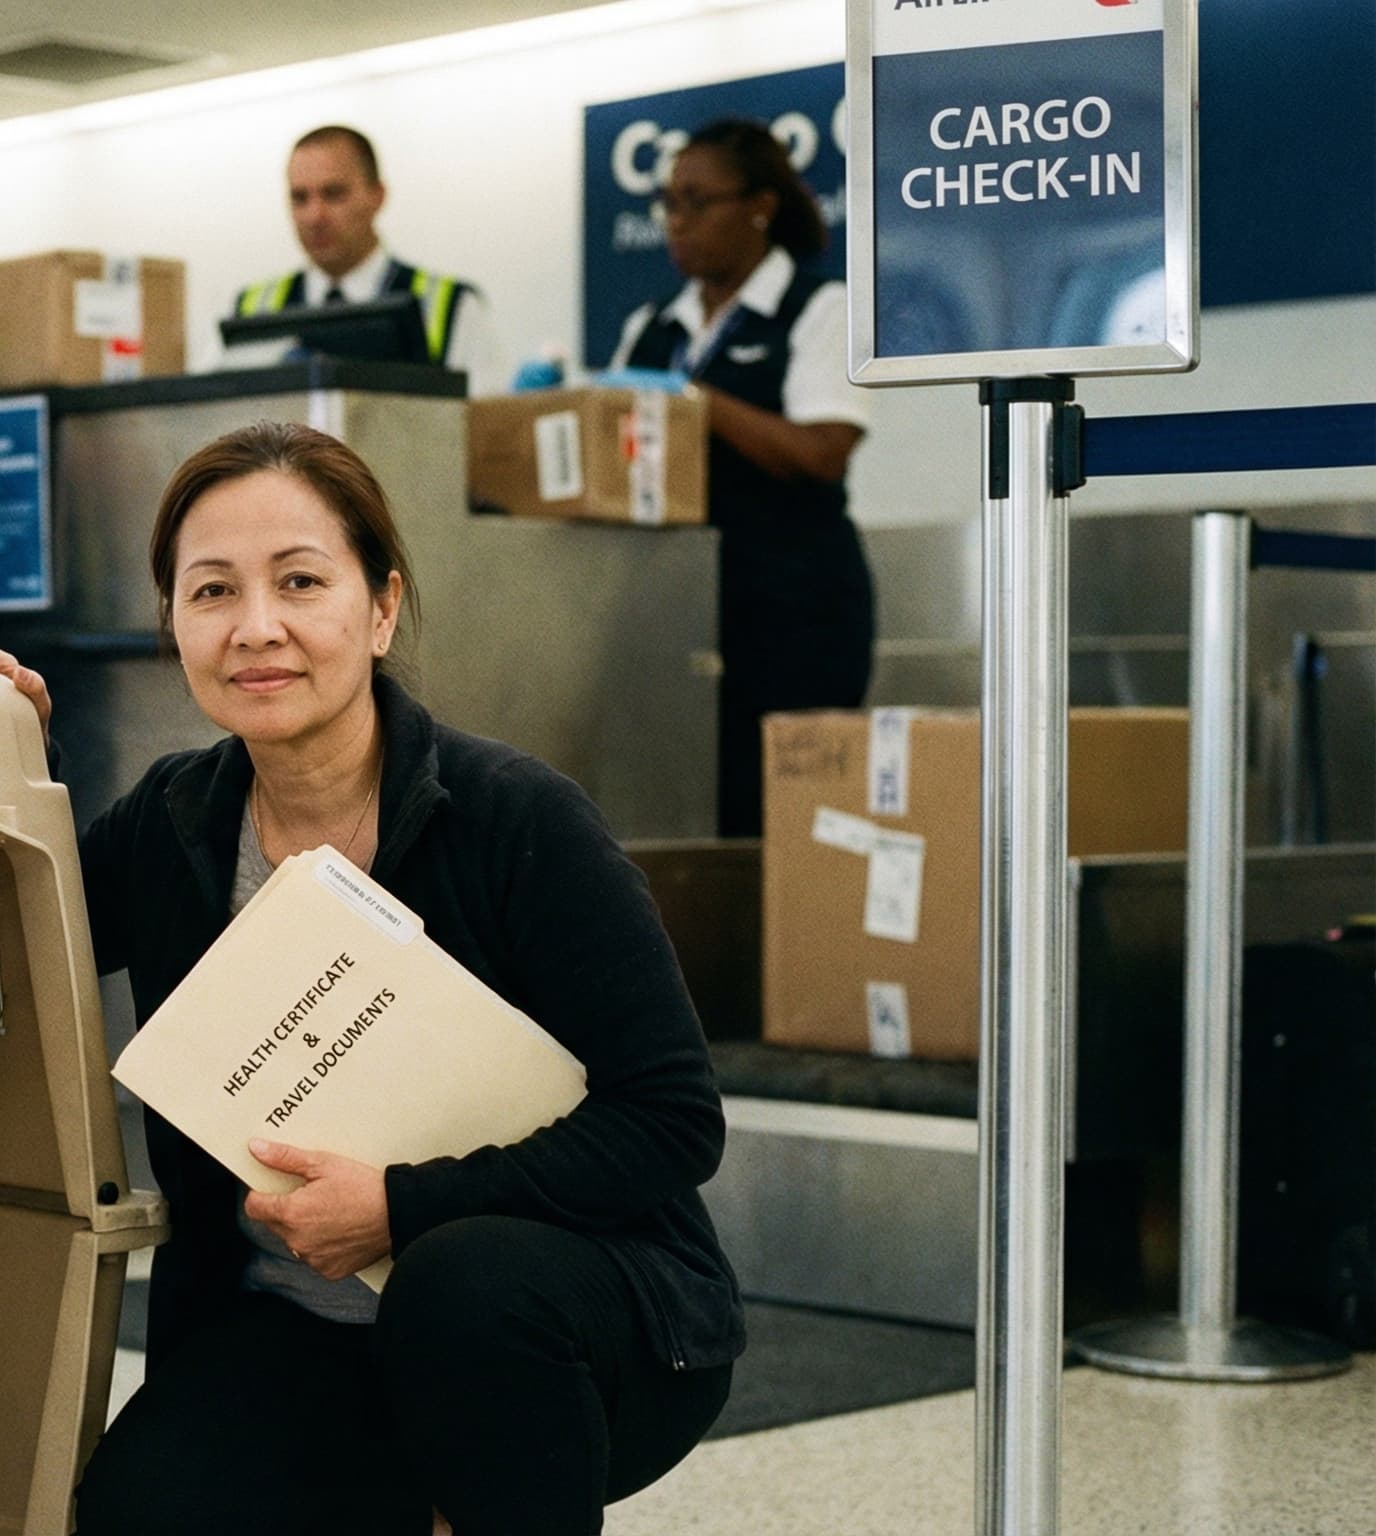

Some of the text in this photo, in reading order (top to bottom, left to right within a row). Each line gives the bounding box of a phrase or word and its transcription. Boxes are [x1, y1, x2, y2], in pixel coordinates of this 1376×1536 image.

[929, 96, 1112, 150] CARGO
[900, 151, 1142, 209] CHECK-IN
[223, 952, 356, 1097] HEALTH CERTIFICATE
[302, 1032, 321, 1048] &
[264, 1076, 319, 1128] TRAVEL
[312, 988, 396, 1078] DOCUMENTS
